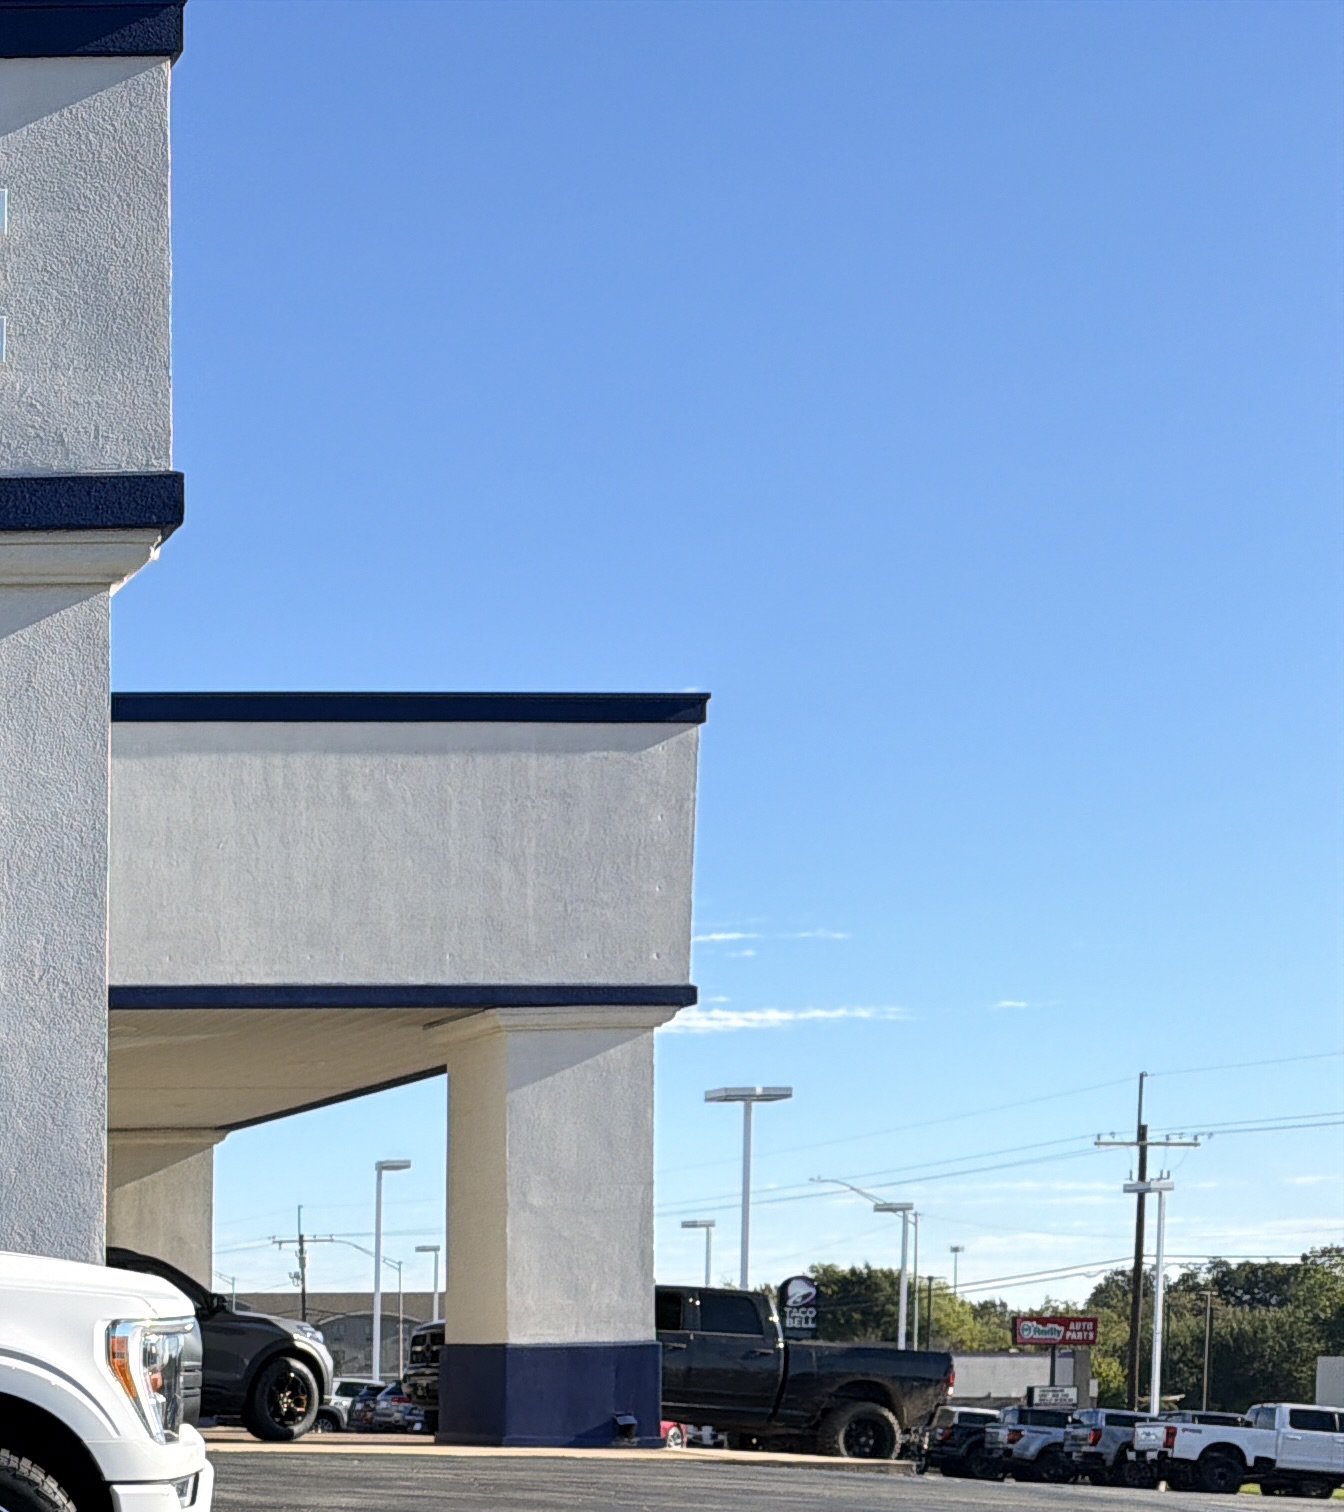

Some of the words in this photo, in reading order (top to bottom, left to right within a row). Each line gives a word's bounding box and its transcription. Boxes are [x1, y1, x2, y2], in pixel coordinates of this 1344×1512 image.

[783, 1306, 817, 1318] TACO
[785, 1317, 817, 1329] BELL
[1069, 1321, 1094, 1330] AUTO
[1065, 1330, 1095, 1341] PARTS
